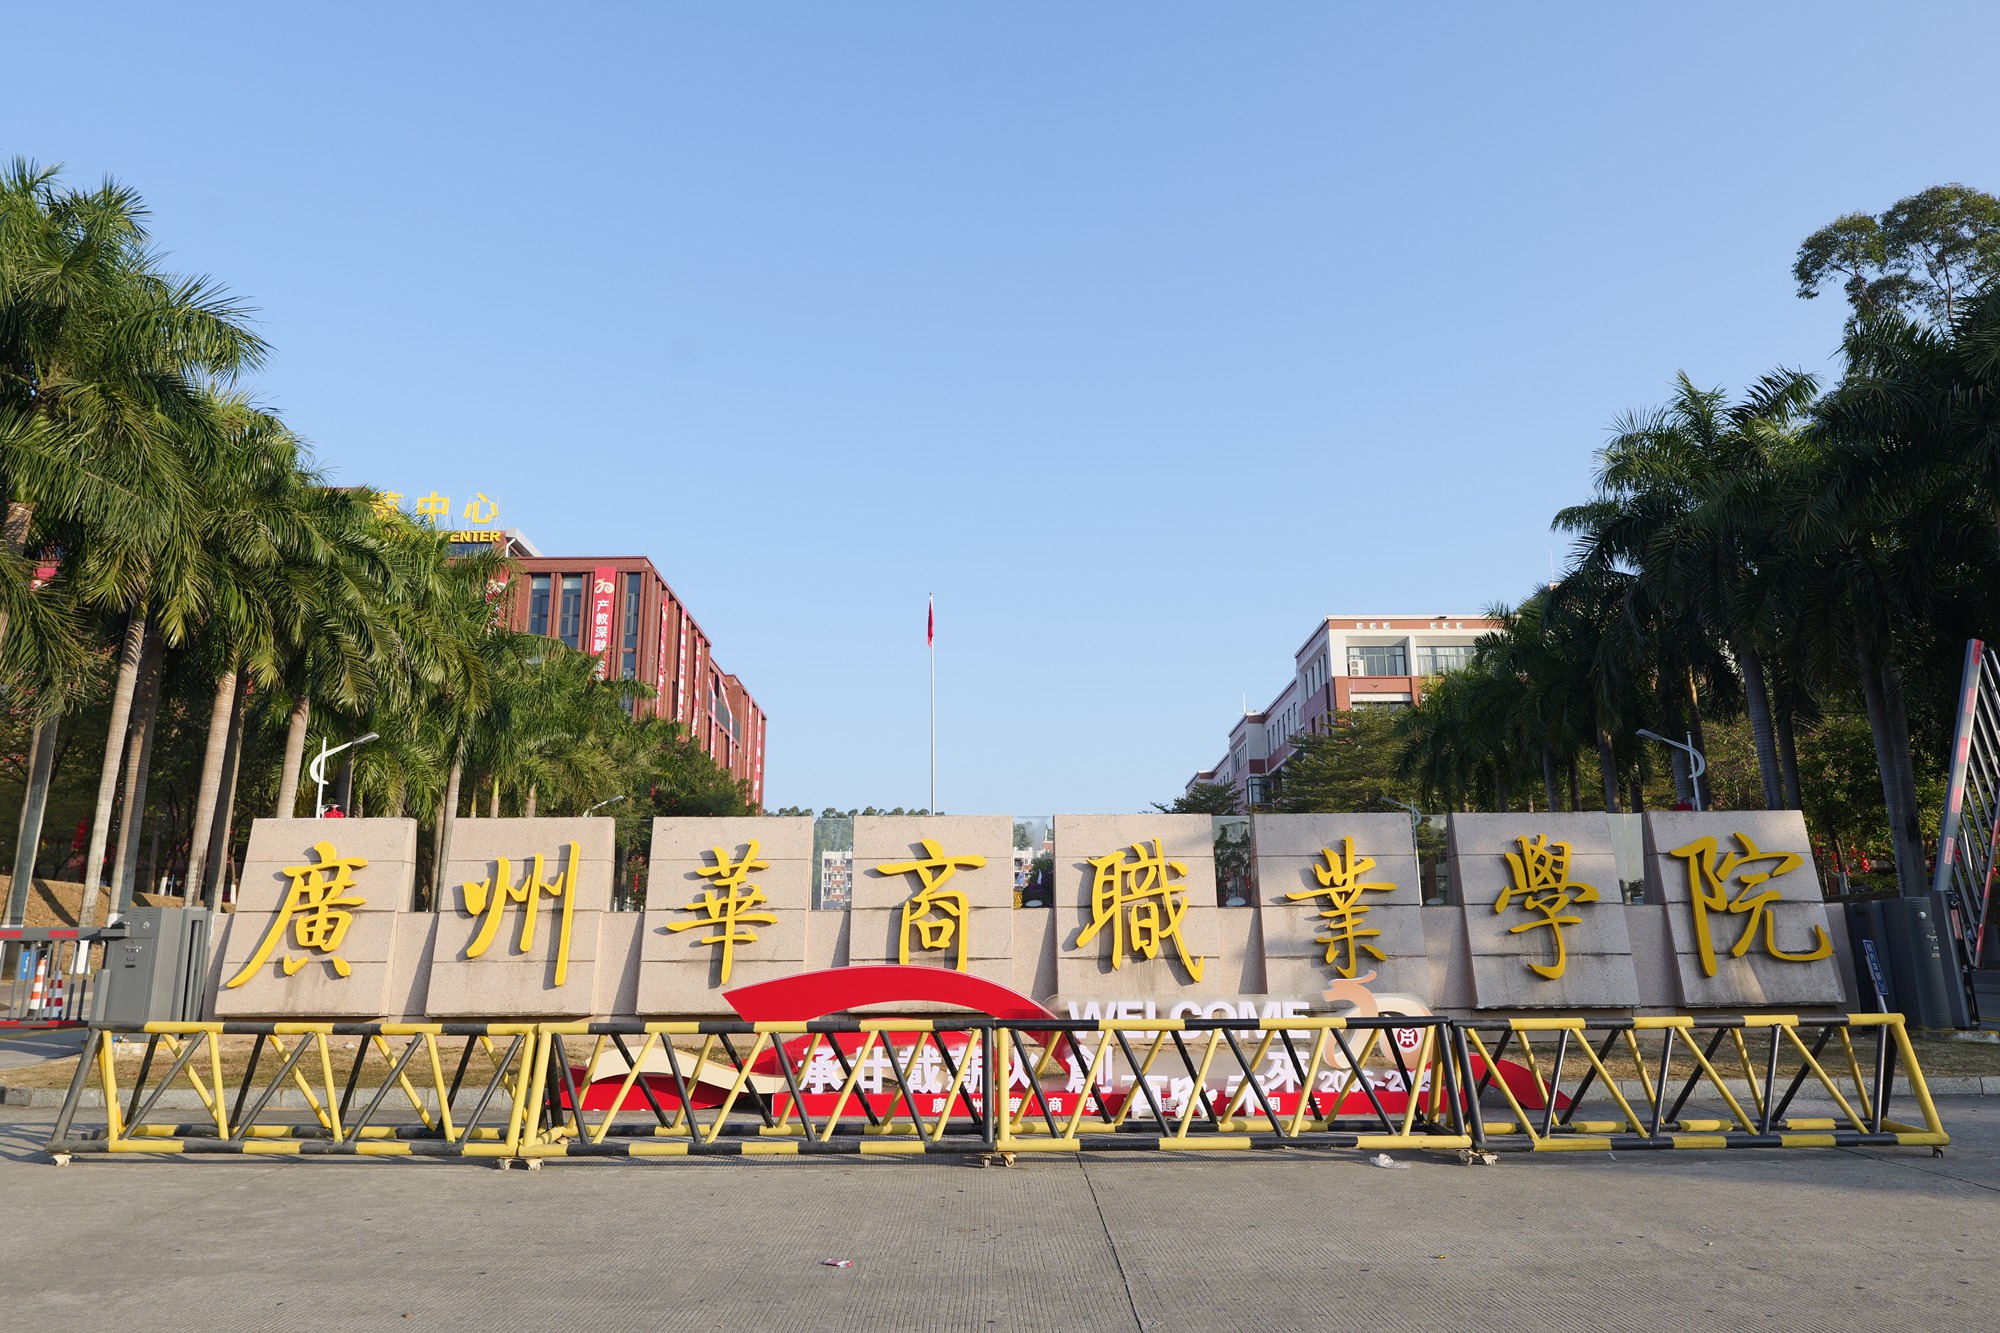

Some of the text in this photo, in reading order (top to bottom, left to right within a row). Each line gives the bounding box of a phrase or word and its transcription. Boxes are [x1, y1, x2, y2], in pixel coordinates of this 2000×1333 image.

[227, 831, 1834, 984] 廣州華商職業學院
[1067, 1000, 1311, 1039] WELCOME
